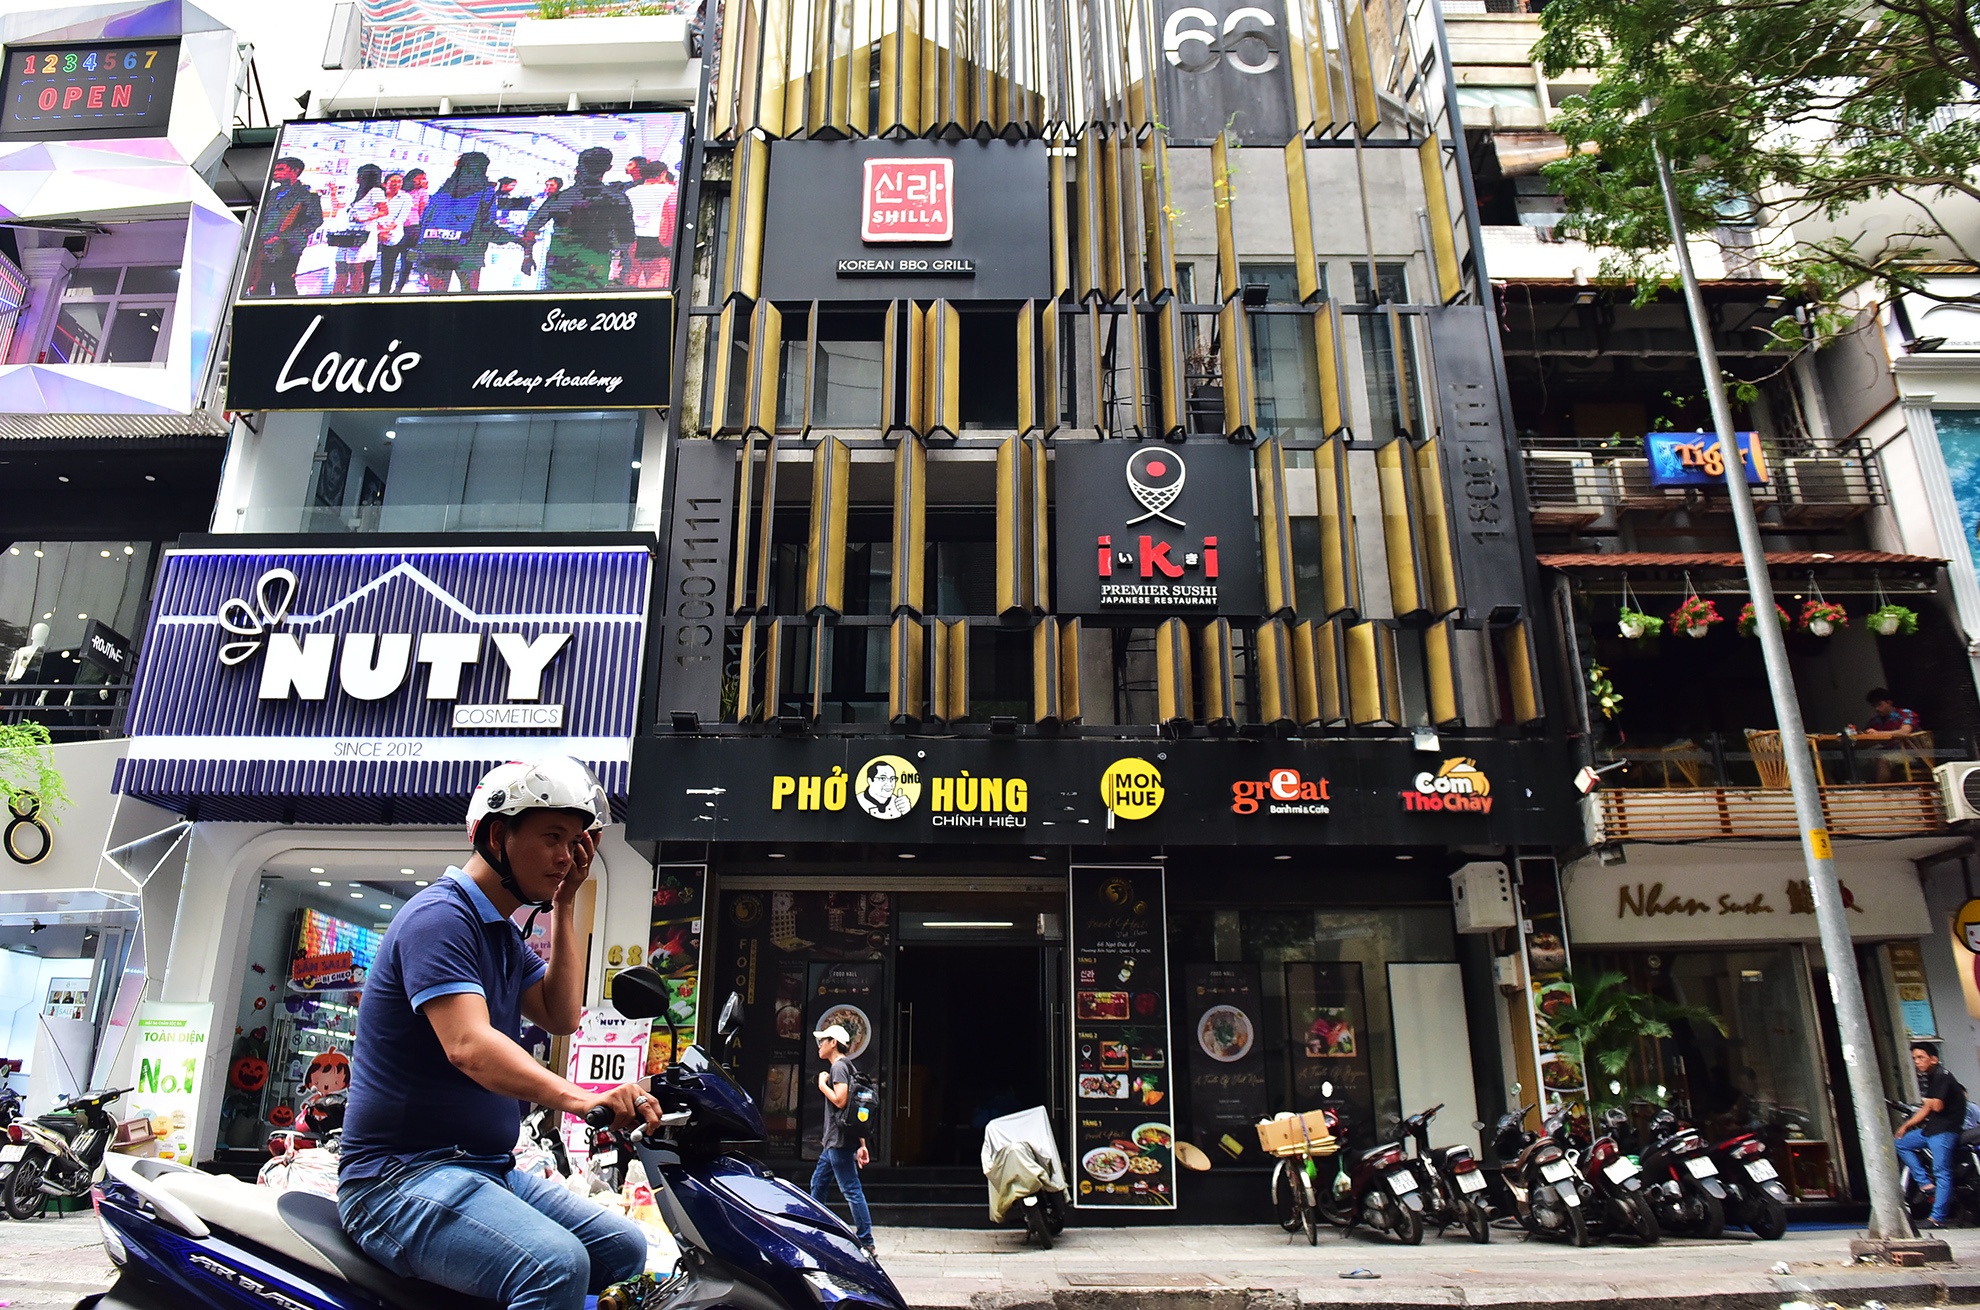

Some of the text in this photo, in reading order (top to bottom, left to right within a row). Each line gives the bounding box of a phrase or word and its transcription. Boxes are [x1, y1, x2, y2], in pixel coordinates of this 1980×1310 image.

[1164, 7, 1280, 75] 66
[38, 84, 133, 111] OPEN
[874, 169, 945, 205] 신라
[872, 210, 944, 224] SHILLA
[838, 260, 973, 270] KOREAN BBQ GRILL
[541, 308, 638, 332] Since 2008
[275, 314, 422, 393] Louis
[472, 368, 623, 393] Makeup Academy
[1674, 441, 1748, 476] Tigr
[1100, 596, 1217, 605] JAPANESE RESTAURANT
[1101, 585, 1218, 597] PREMIER SUSHI
[91, 634, 124, 663] ROUTINE
[258, 632, 575, 700] NUTY
[454, 708, 559, 725] COSMETICS
[333, 742, 424, 757] SINCE 2012
[771, 765, 849, 811] PHỞ
[900, 770, 922, 785] ÔNG
[1116, 773, 1164, 788] MON
[1415, 772, 1473, 794] Cơm
[931, 770, 1029, 813] HÙNG
[1116, 790, 1157, 806] HUE
[1231, 768, 1331, 815] great
[932, 813, 1027, 829] CHÍNH HIỆU
[1618, 882, 1711, 918] Nhan
[607, 944, 643, 966] 68
[144, 1029, 205, 1045] TOÀN DIỆN
[138, 1057, 197, 1094] No.1
[589, 1053, 626, 1081] BIG
[189, 1254, 237, 1281] AIR
